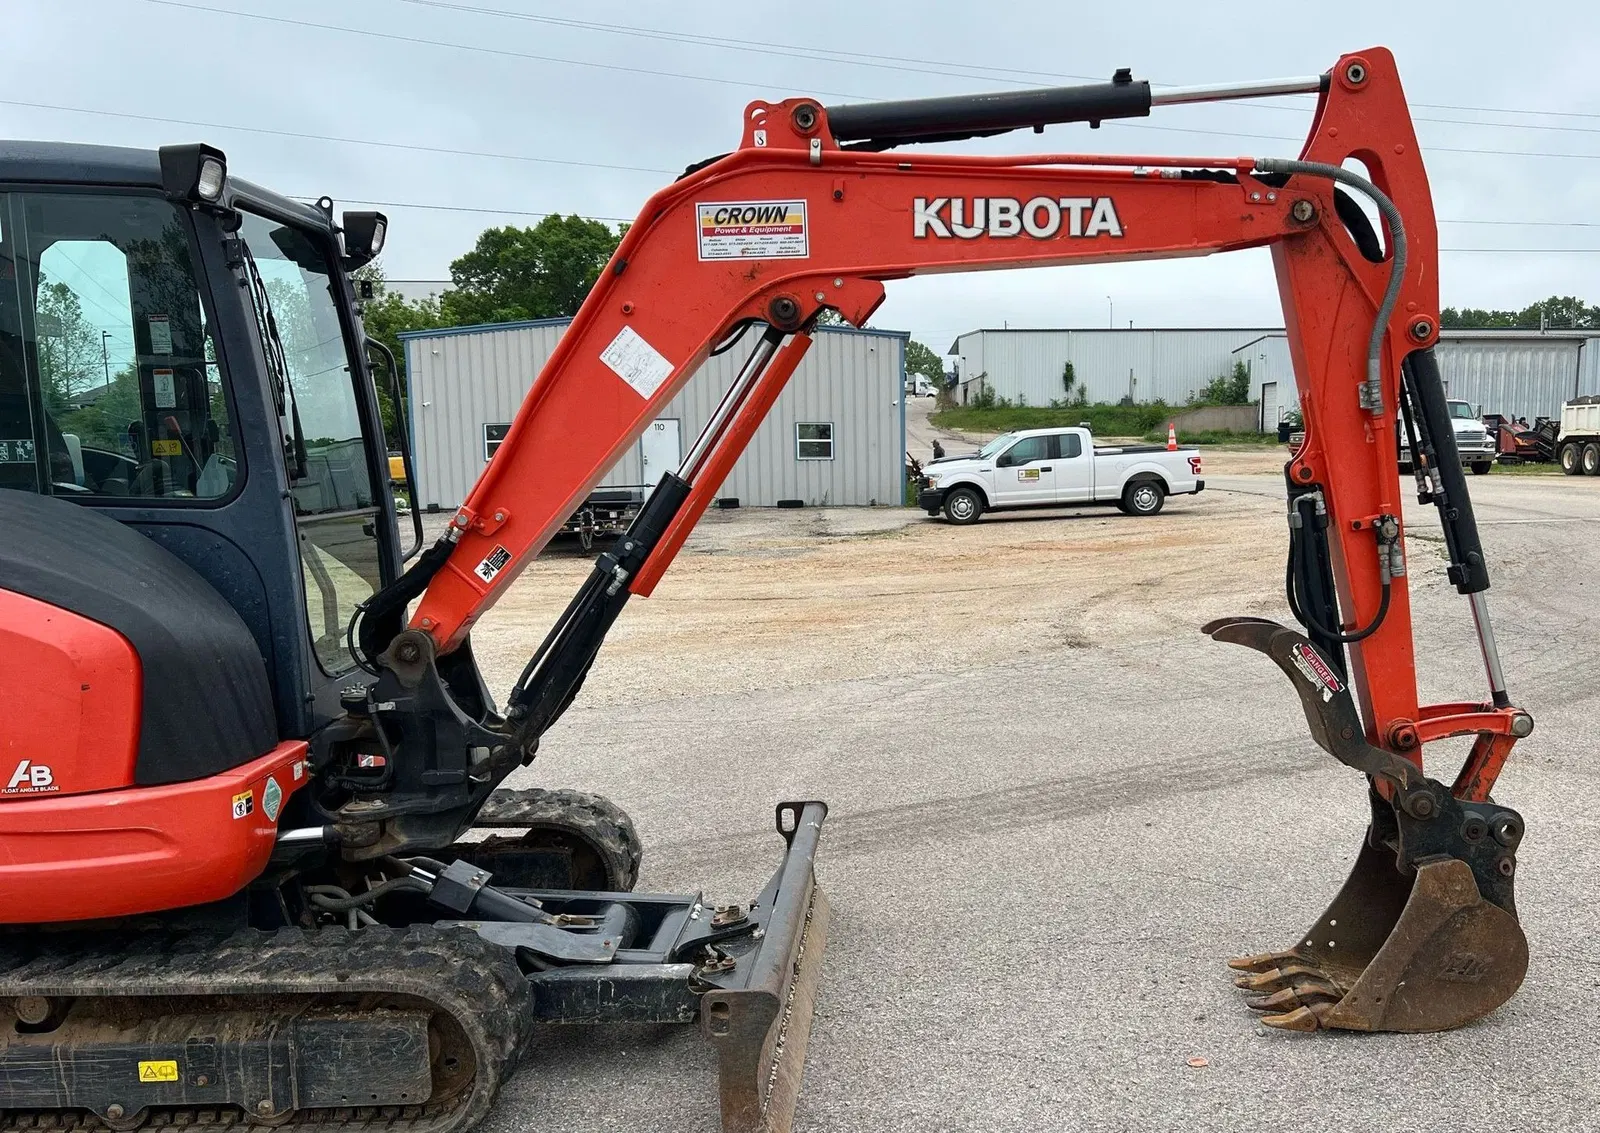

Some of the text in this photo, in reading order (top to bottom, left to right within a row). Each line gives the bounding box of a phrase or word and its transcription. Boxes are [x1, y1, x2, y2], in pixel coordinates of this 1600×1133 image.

[714, 206, 788, 225] CROWN
[913, 196, 1123, 239] KUBOTA
[749, 226, 792, 234] Equipment
[654, 423, 665, 431] 110
[1306, 653, 1331, 682] DANGER
